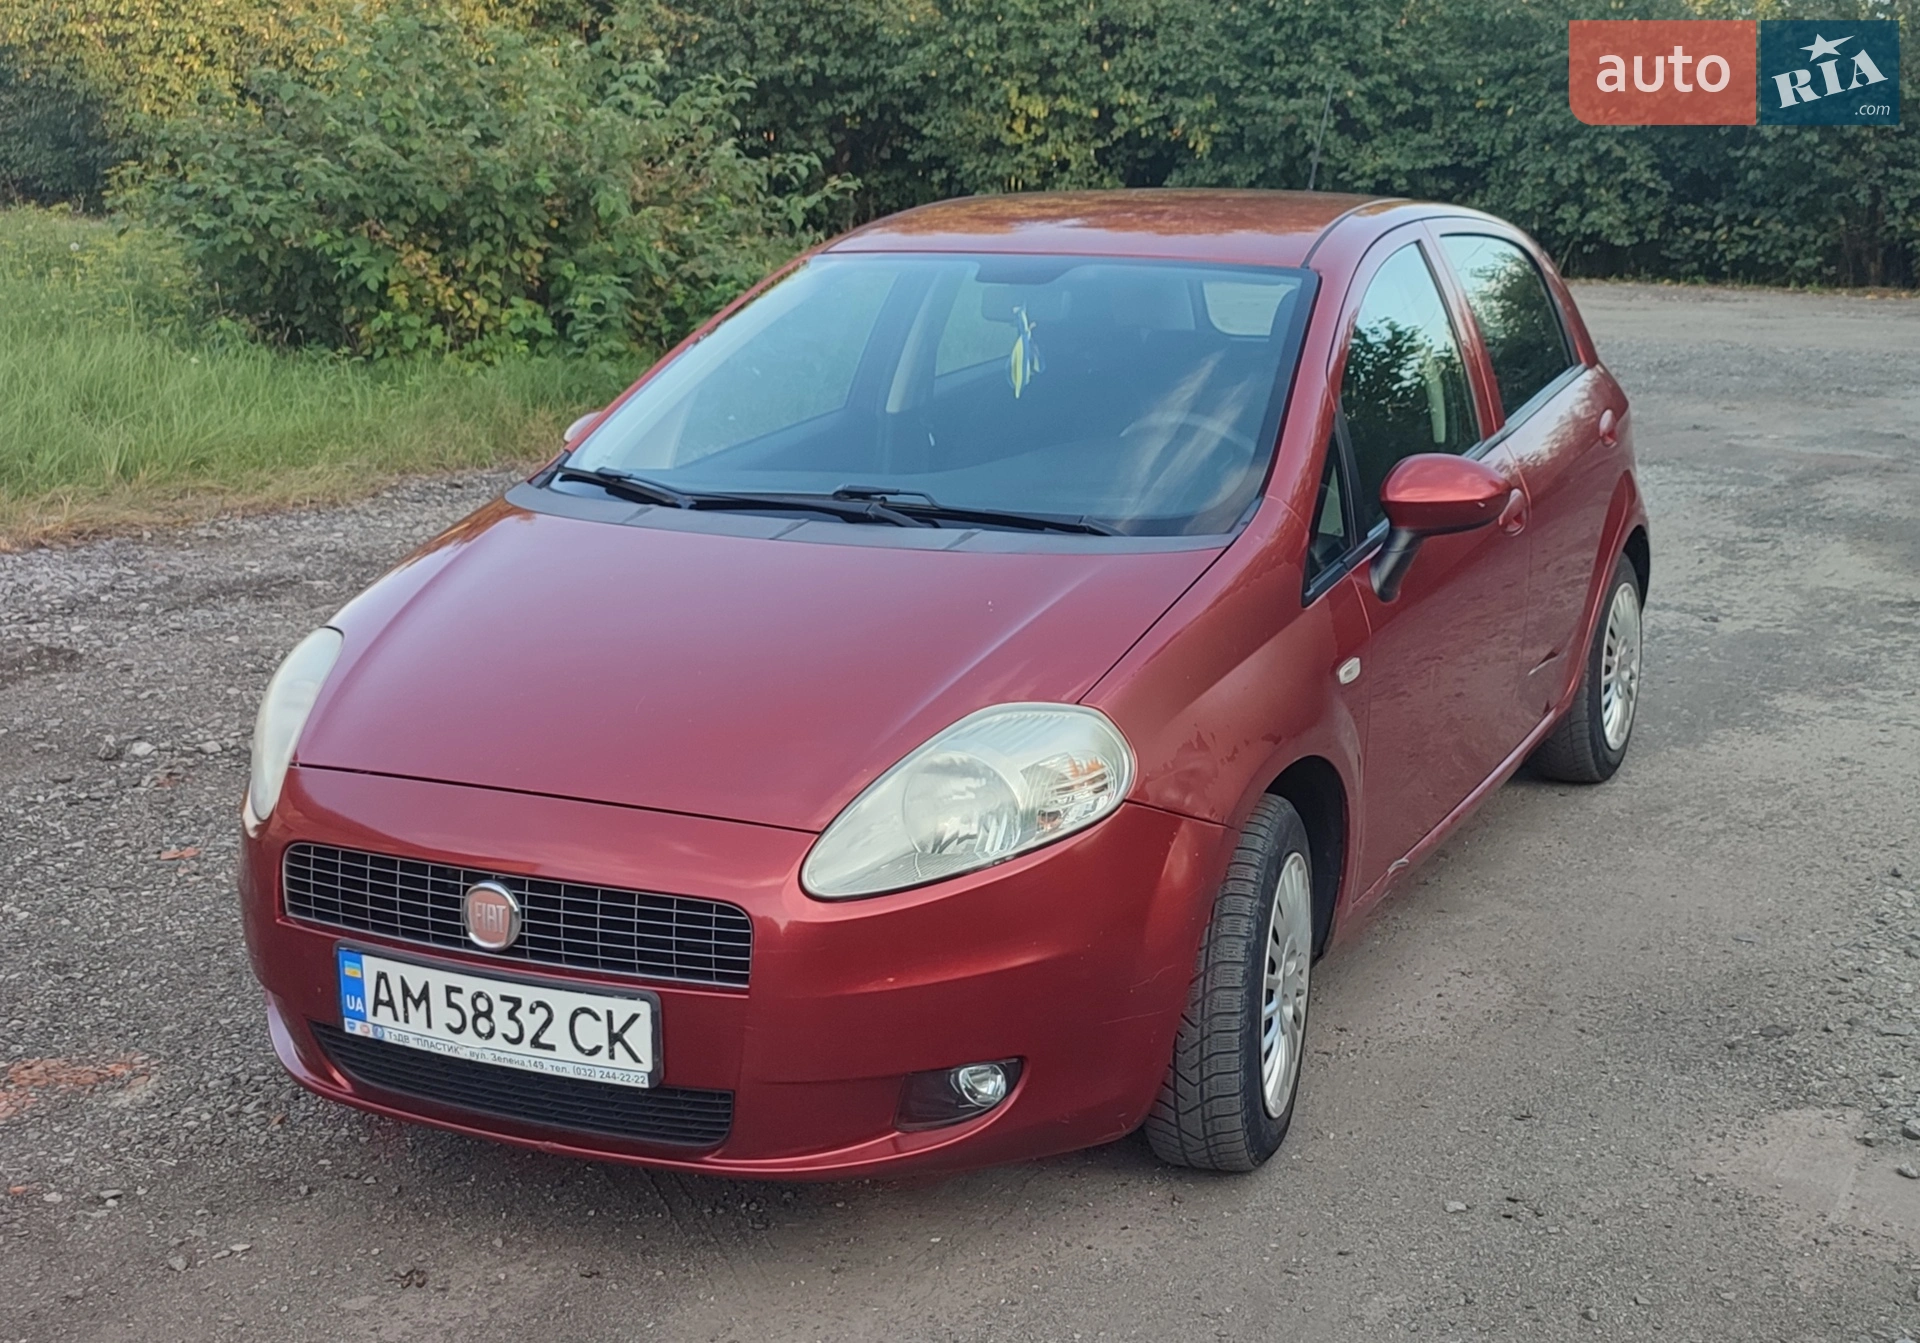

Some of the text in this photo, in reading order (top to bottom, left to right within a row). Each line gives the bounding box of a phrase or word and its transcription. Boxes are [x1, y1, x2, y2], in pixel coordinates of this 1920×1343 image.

[475, 901, 507, 933] FIAT
[346, 994, 365, 1013] UA
[372, 970, 644, 1064] AM 5832 CK
[572, 1065, 597, 1079] (032)
[599, 1070, 646, 1085] 244-22-22
